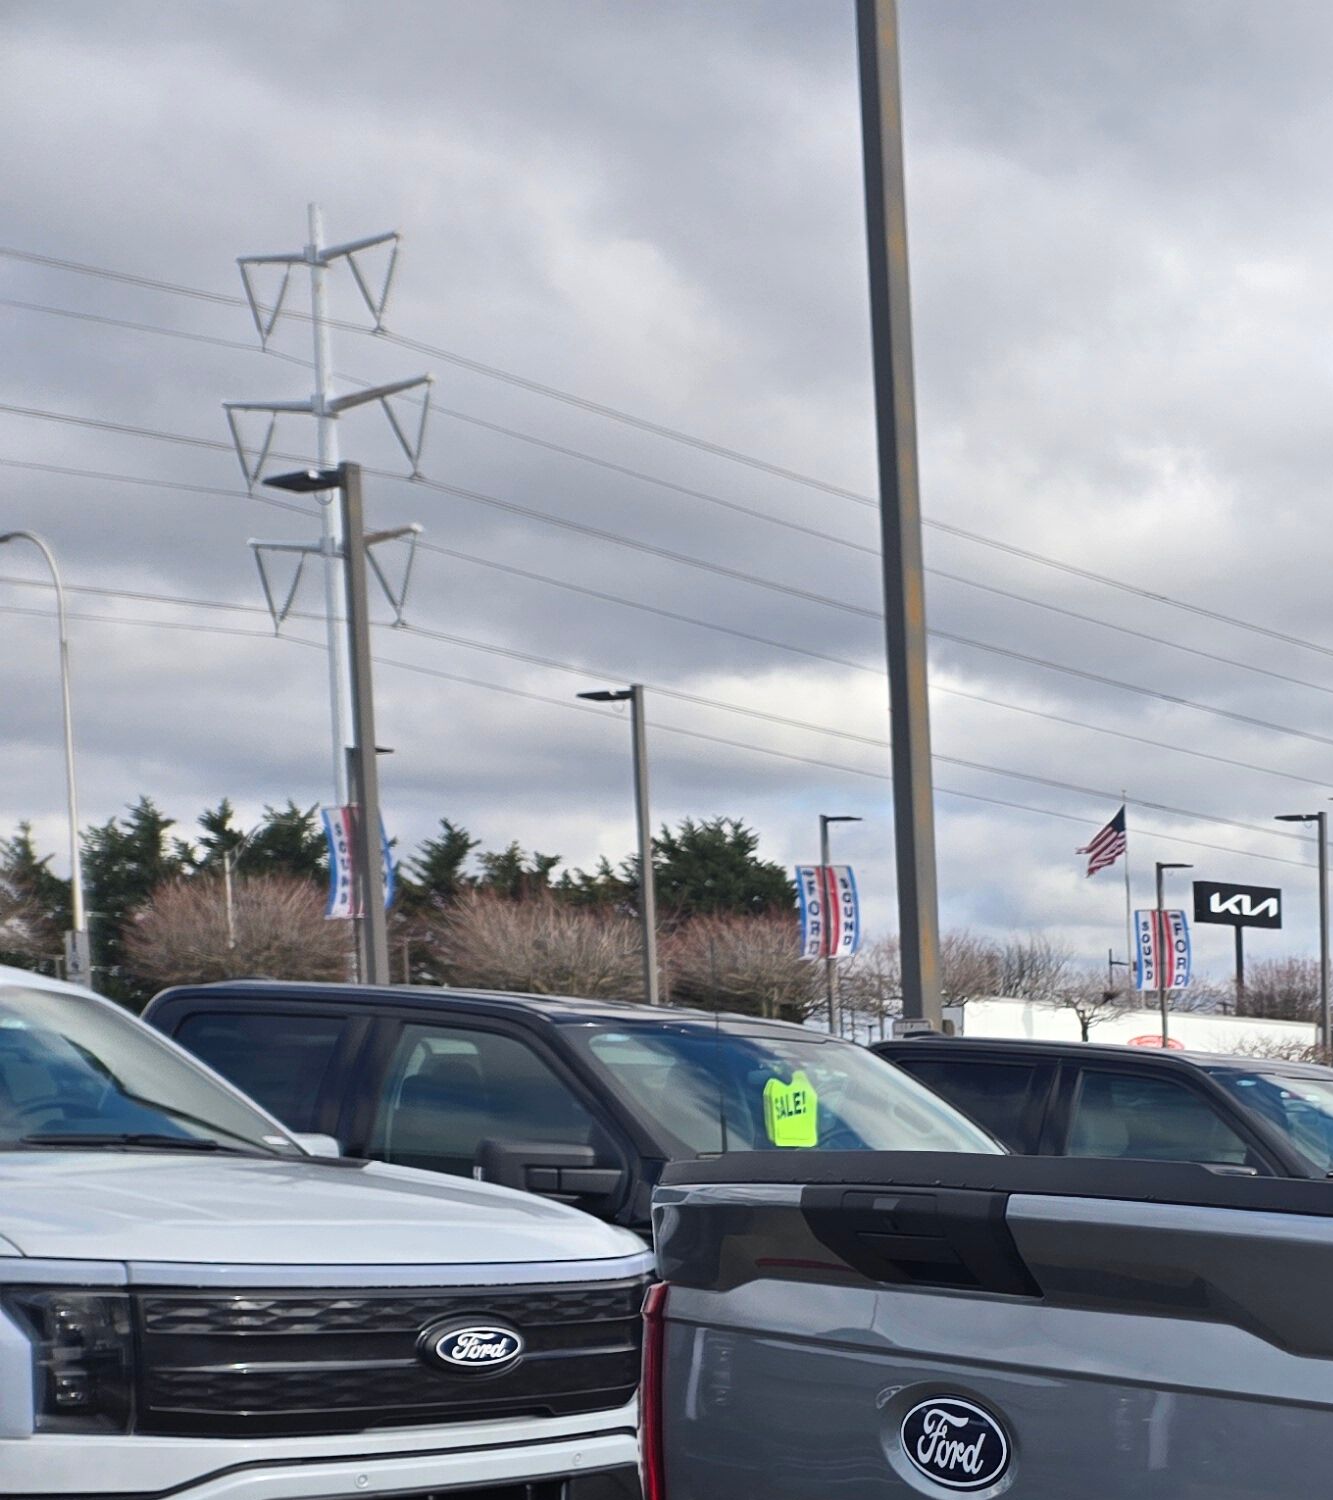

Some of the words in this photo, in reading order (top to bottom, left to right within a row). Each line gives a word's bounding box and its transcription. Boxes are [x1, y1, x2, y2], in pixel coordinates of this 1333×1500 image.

[806, 880, 821, 956] FORD
[1210, 892, 1279, 918] KIA
[1141, 921, 1154, 981] SOUND
[1173, 923, 1187, 986] FORD
[775, 1090, 807, 1120] SALE!
[451, 1332, 510, 1360] Ford
[917, 1408, 987, 1475] Ford
